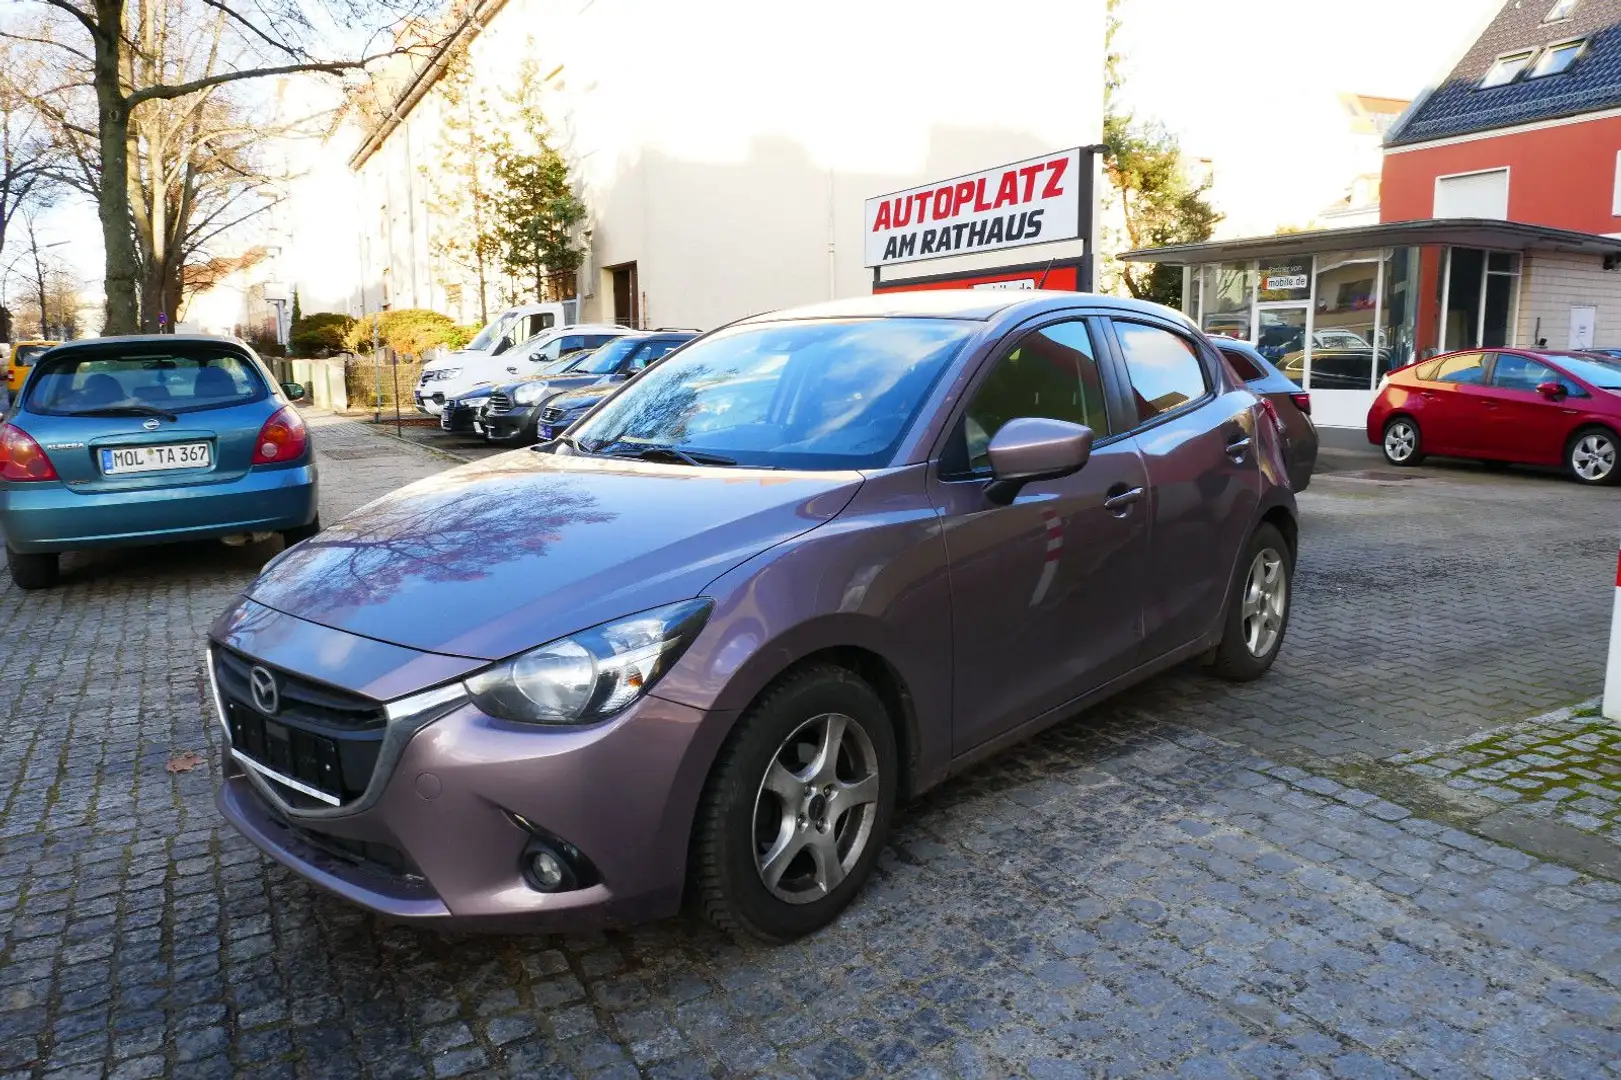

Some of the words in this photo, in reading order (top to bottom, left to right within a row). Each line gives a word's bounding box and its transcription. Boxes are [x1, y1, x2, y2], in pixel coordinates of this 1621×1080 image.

[872, 157, 1069, 232] AUTOPLATZ
[883, 232, 917, 260] AM
[919, 208, 1045, 255] RATHAUS
[1269, 276, 1306, 288] mobile.de
[114, 450, 144, 467] MOL
[156, 448, 176, 463] TA
[180, 446, 206, 462] 367
